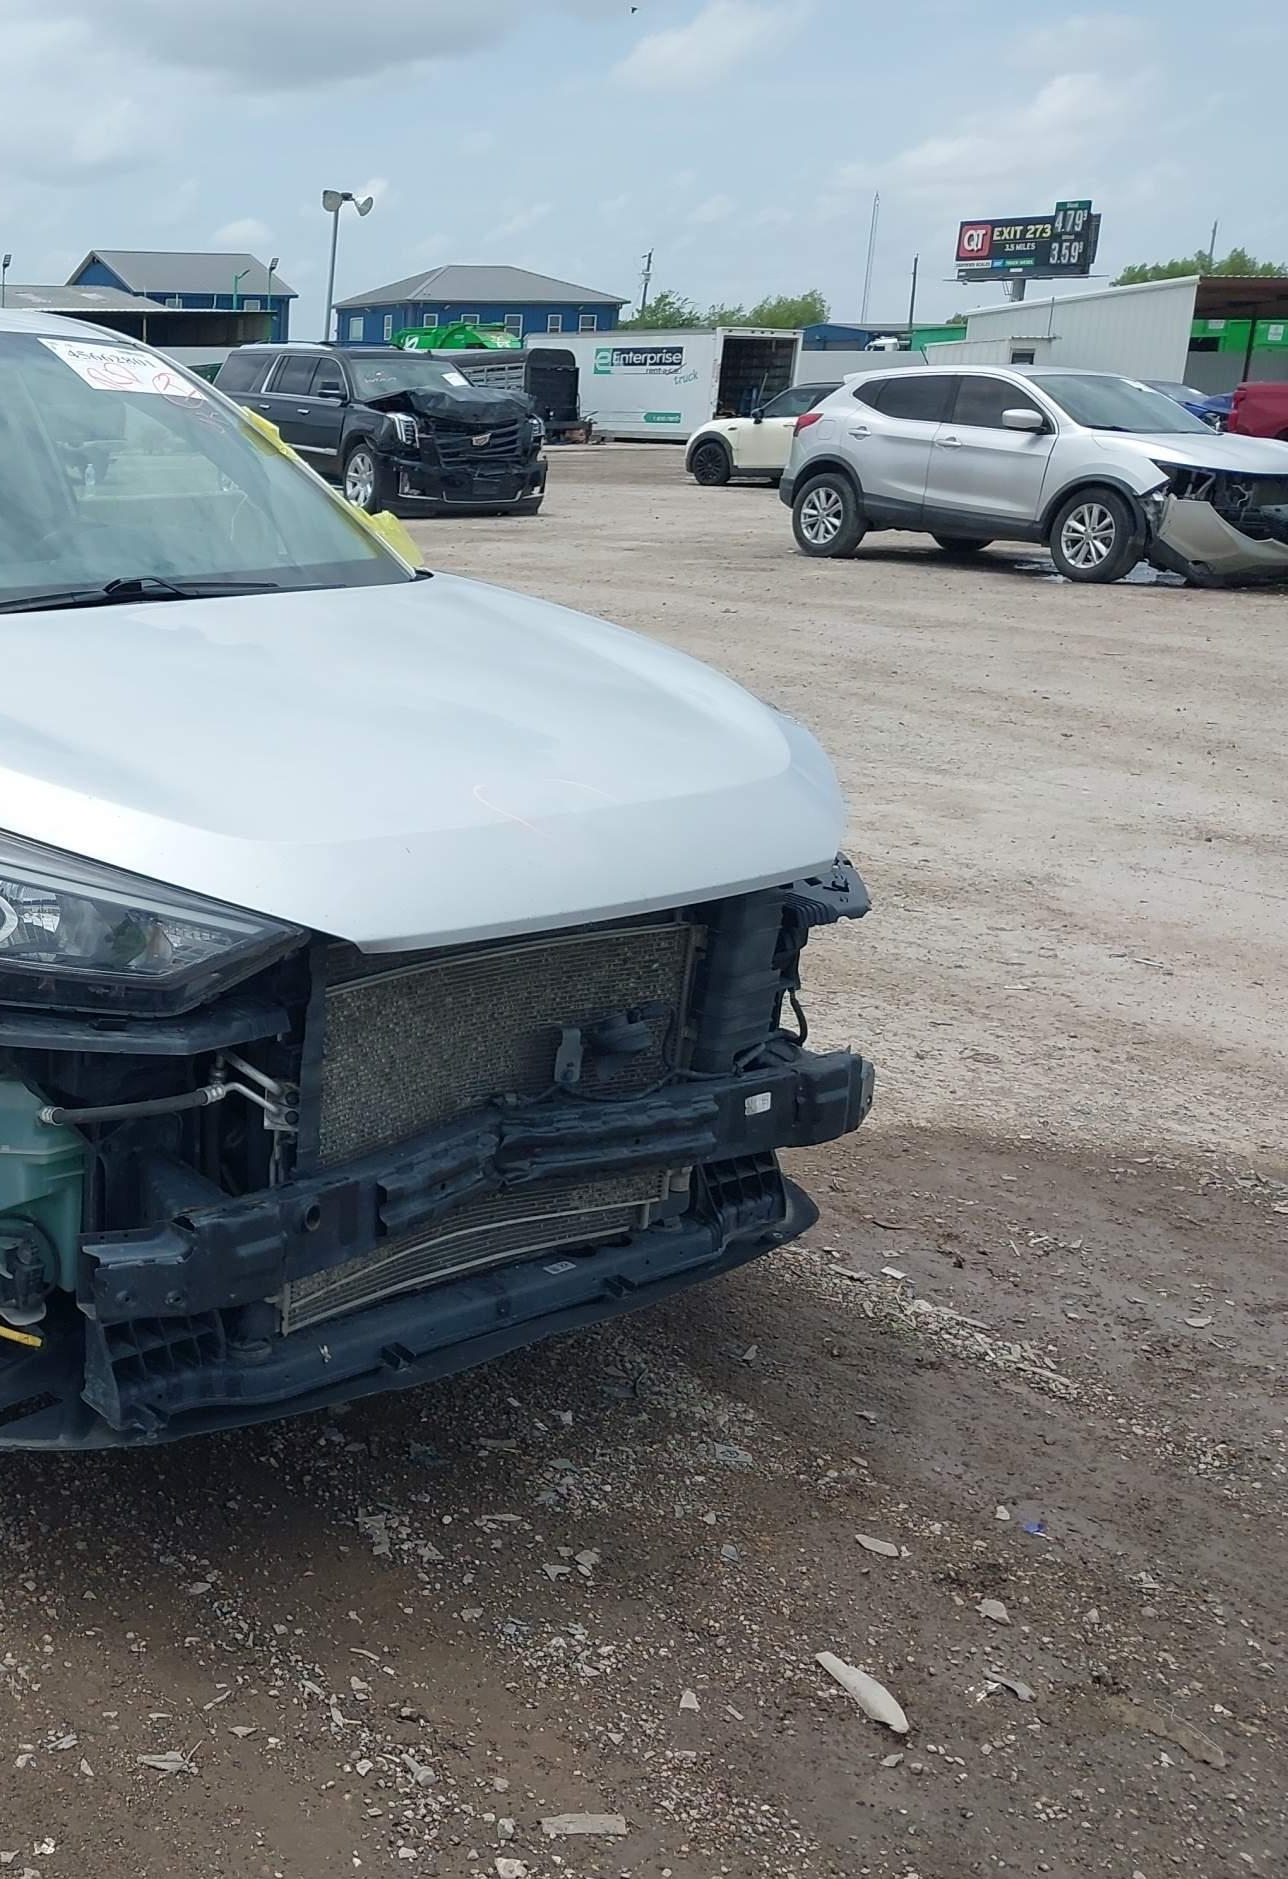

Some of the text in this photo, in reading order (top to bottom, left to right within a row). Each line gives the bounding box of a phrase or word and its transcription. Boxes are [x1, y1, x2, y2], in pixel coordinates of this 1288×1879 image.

[993, 223, 1052, 241] EXIT 273
[963, 229, 987, 253] QT
[1015, 242, 1036, 251] MILES
[612, 349, 682, 366] Enterprise
[673, 369, 699, 385] truck
